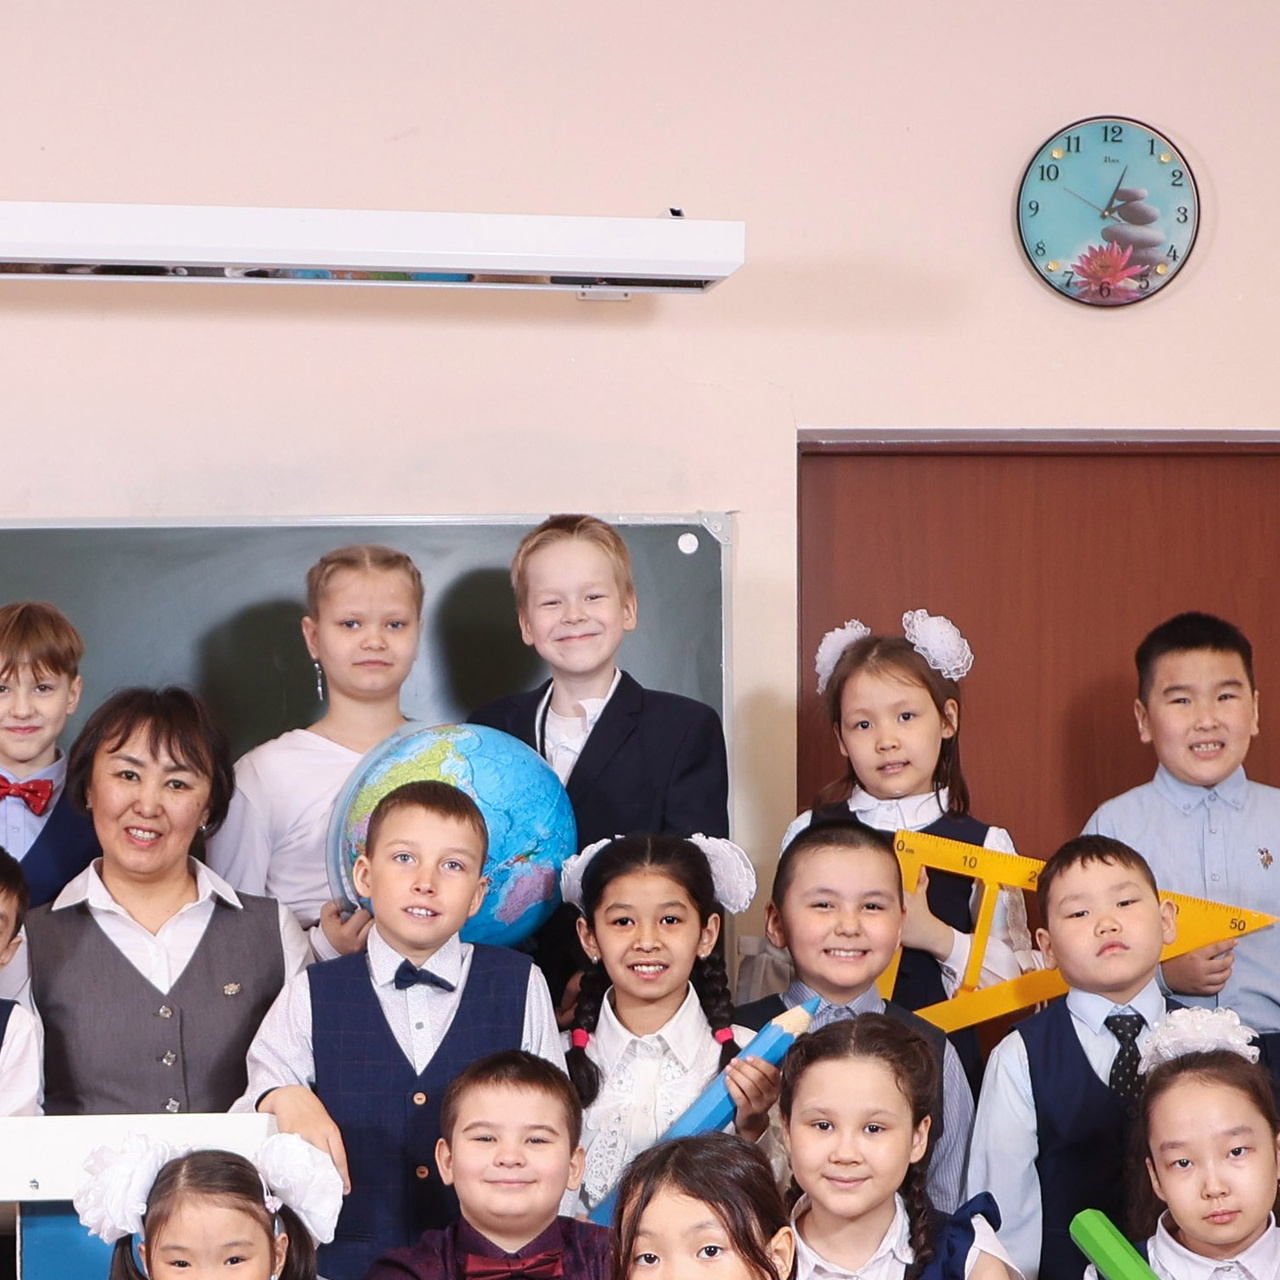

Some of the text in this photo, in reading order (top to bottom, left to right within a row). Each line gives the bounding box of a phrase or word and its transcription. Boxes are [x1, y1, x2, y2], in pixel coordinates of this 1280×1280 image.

[1101, 125, 1123, 143] 12
[1065, 136, 1081, 152] 11
[1147, 138, 1155, 155] 1
[1039, 164, 1059, 181] 10
[1171, 169, 1183, 187] 2
[1028, 201, 1039, 217] 9
[1176, 206, 1188, 223] 3
[1035, 240, 1046, 256] 8
[1166, 245, 1179, 261] 4
[1062, 271, 1074, 287] 7
[1139, 274, 1149, 290] 5
[1099, 281, 1111, 298] 6
[896, 840, 905, 852] 0
[963, 855, 977, 868] 10
[1028, 871, 1038, 883] 2
[1229, 918, 1246, 931] 50
